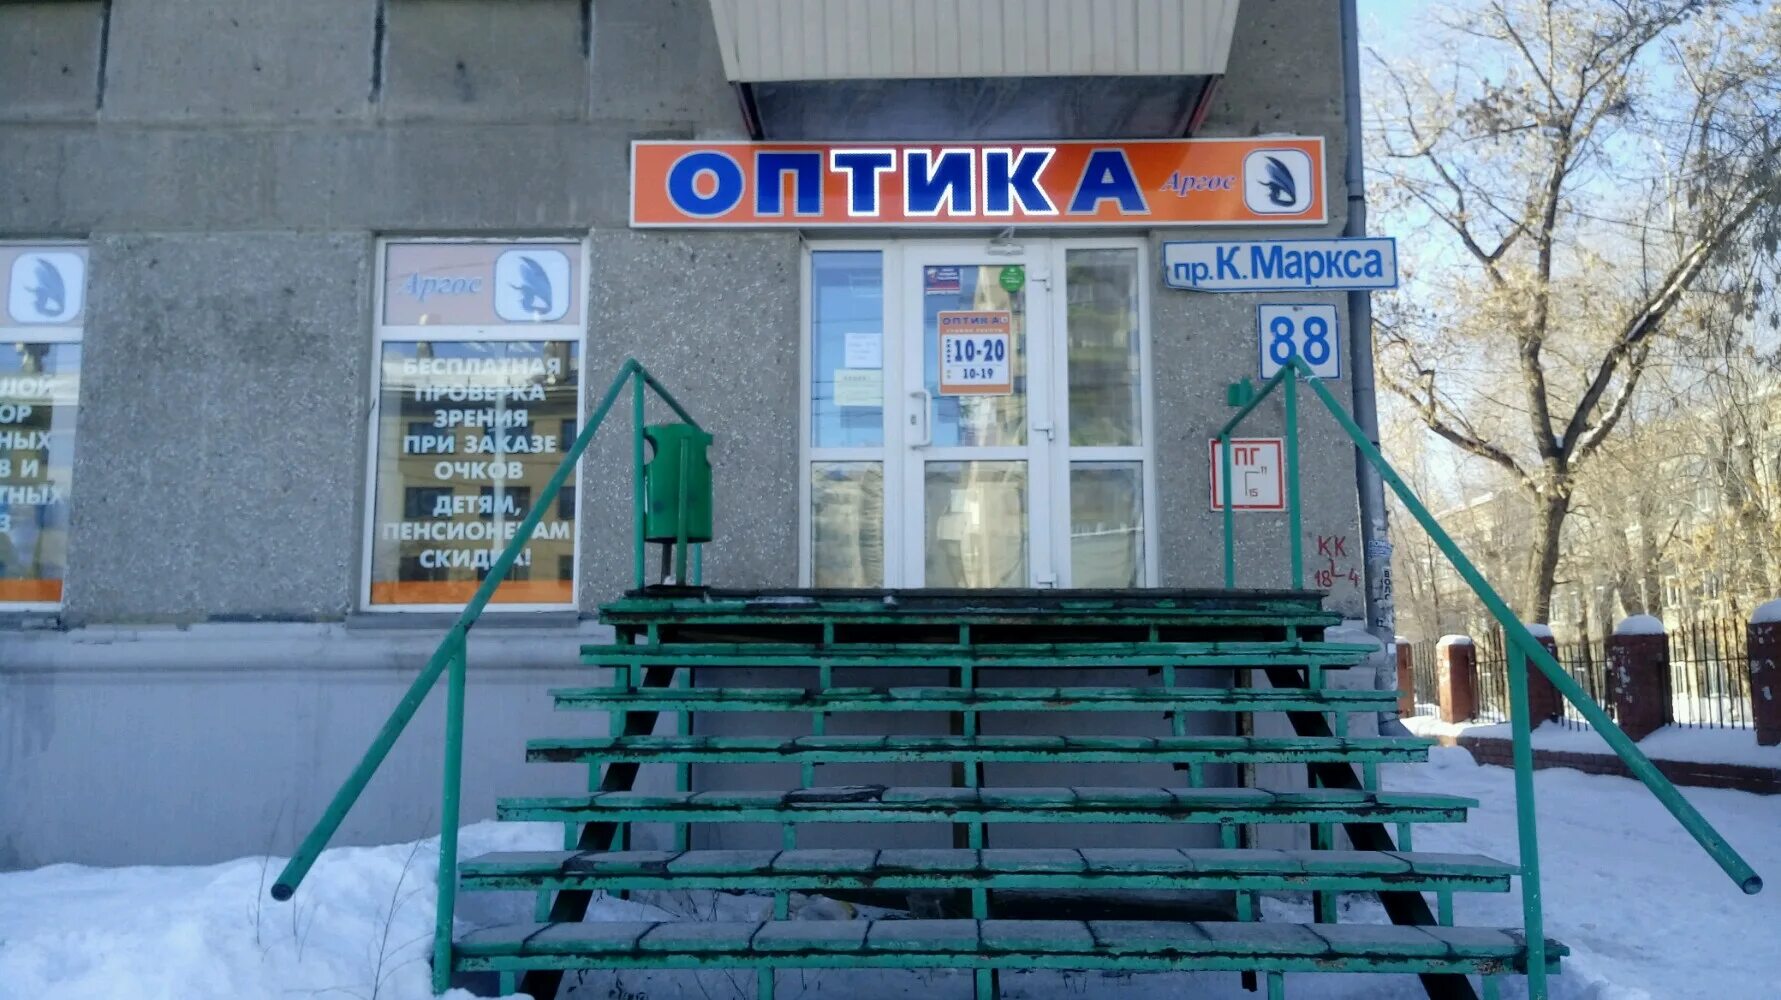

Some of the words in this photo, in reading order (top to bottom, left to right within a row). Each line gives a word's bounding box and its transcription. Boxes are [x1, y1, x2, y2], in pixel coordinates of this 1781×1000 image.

[665, 148, 1151, 218] ОПТИКА
[1160, 170, 1236, 198] Аргос
[398, 272, 483, 302] Аргос
[942, 317, 998, 325] ОПТИКА
[1269, 316, 1330, 365] 88
[955, 339, 1004, 362] 10-20
[403, 358, 561, 375] БЕСПЛАТНАЯ
[963, 368, 994, 379] 10-19
[415, 384, 546, 401] ПРОВЕРКА
[433, 409, 528, 427] ЗРЕНИЯ
[403, 435, 454, 453] ПРИ
[464, 435, 556, 453] ЗАКАЗЕ
[1234, 448, 1260, 466] ПГ
[20, 459, 39, 478] И
[434, 462, 523, 479] ОЧКОВ
[1249, 488, 1259, 497] 15
[433, 496, 521, 517] ДЕТЯМ,
[382, 522, 569, 540] ПЕНСИОНЕАМ
[419, 548, 531, 570] СКИДА!
[1315, 570, 1333, 588] 18
[1348, 568, 1360, 588] 4
